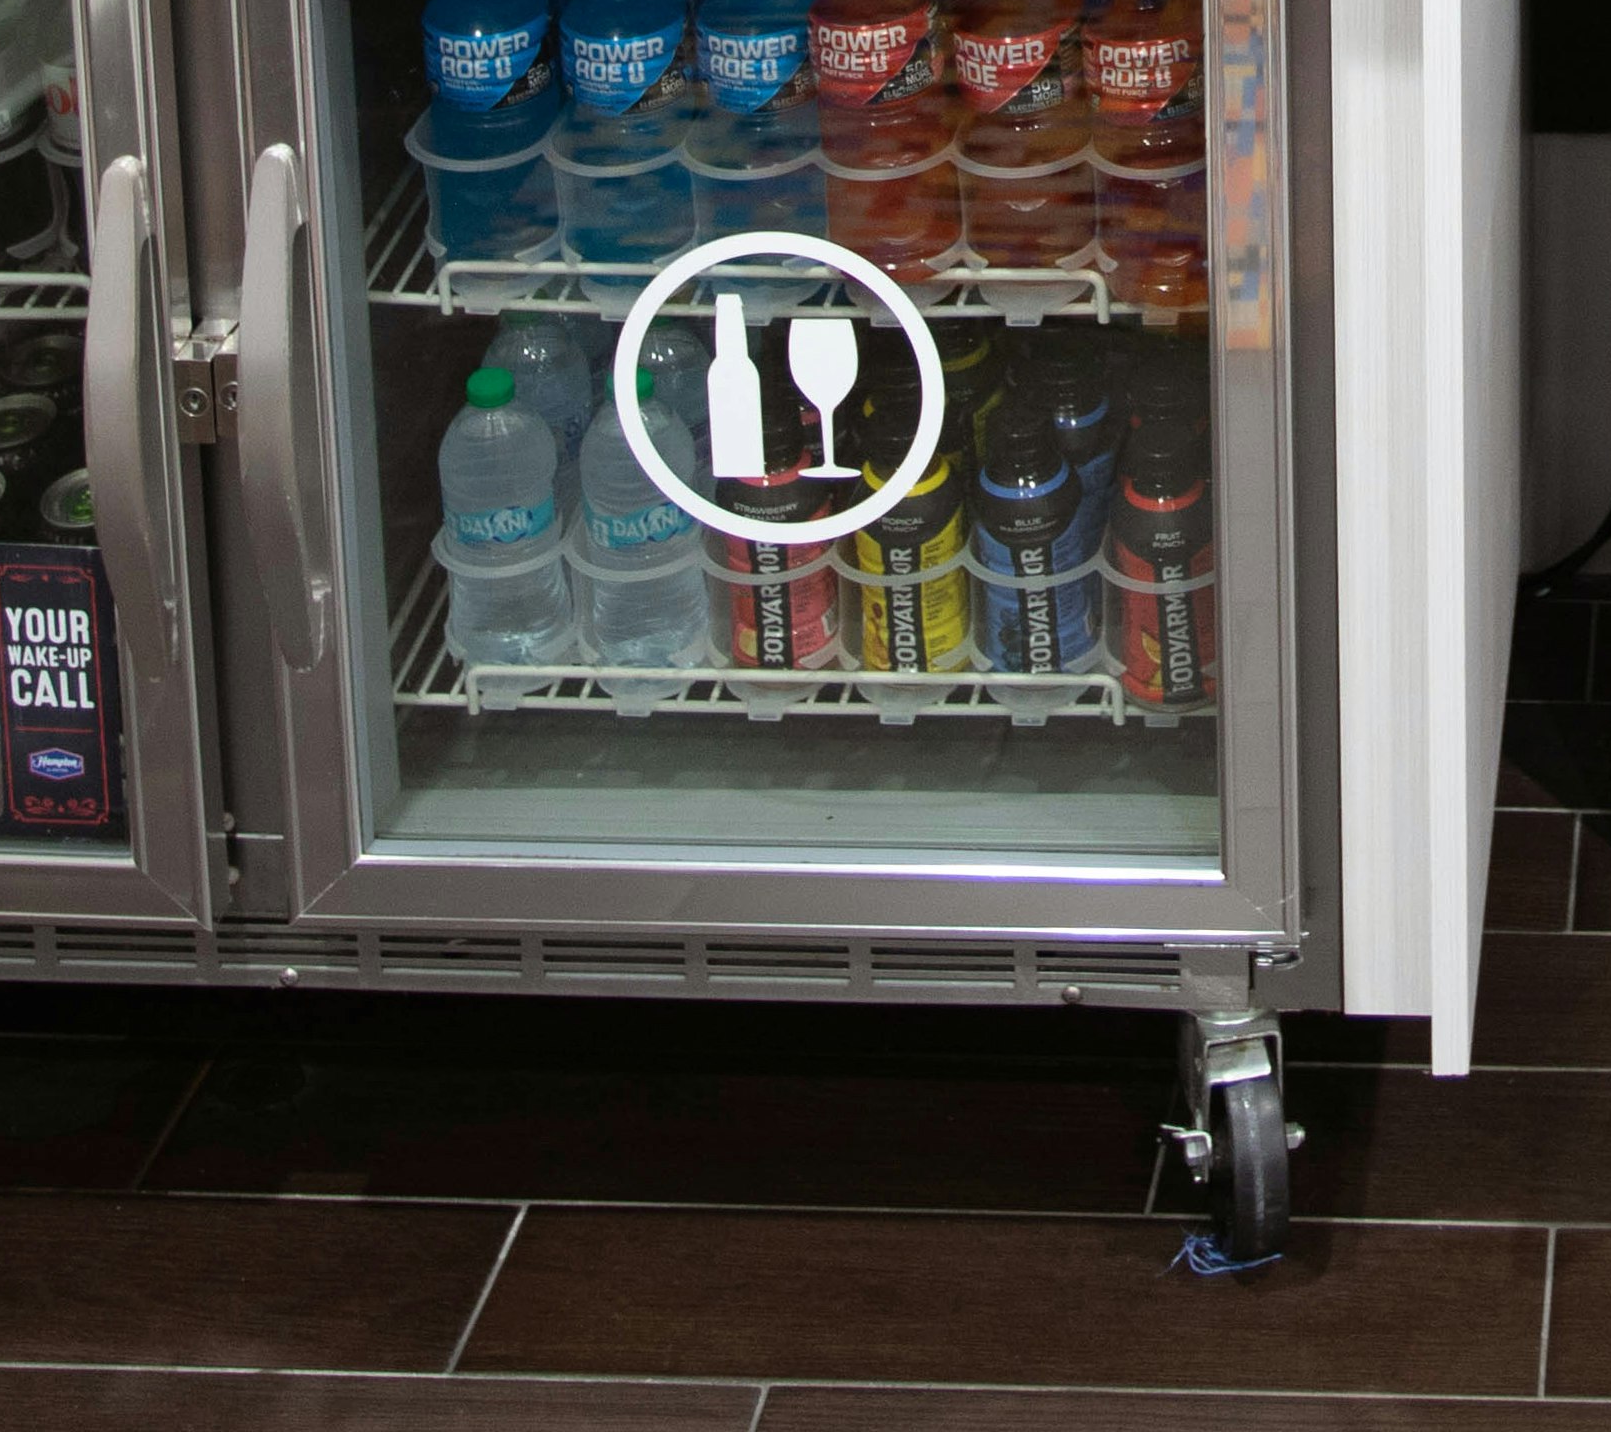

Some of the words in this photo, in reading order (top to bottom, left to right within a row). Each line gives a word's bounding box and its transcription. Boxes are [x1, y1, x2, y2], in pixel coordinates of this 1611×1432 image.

[439, 31, 531, 61] POWER
[708, 34, 797, 60] POWER
[818, 24, 908, 49] POWER
[574, 35, 665, 64] POWER
[821, 50, 870, 72] ADE
[1099, 39, 1189, 68] POWER
[439, 59, 487, 80] ADE
[575, 62, 622, 82] ADE
[1101, 67, 1150, 88] ADE
[733, 502, 799, 513] STRAWBERRY
[459, 514, 531, 537] DASANI
[1014, 517, 1043, 527] BLUE
[4, 607, 90, 645] YOUR
[7, 645, 92, 669] WAKE-UP
[11, 669, 95, 709] CALL
